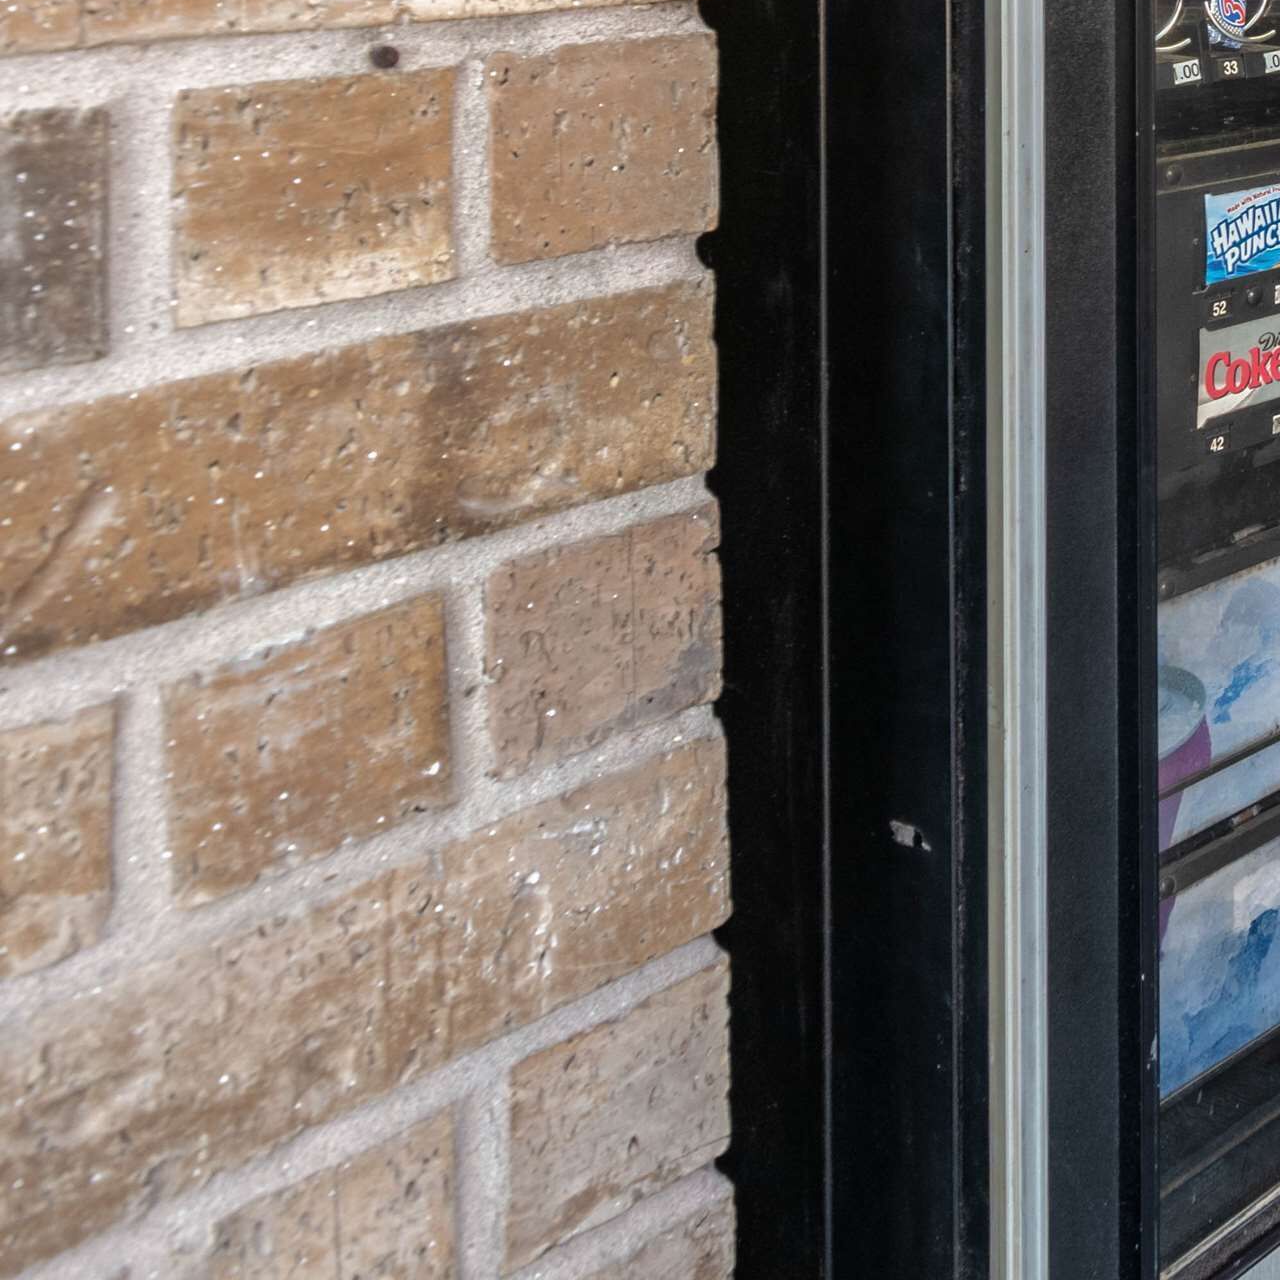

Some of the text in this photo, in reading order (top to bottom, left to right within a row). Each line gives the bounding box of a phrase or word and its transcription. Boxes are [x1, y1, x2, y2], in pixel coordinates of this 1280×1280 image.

[1223, 61, 1238, 75] 33
[1212, 300, 1227, 317] 52
[1209, 436, 1225, 453] 42
